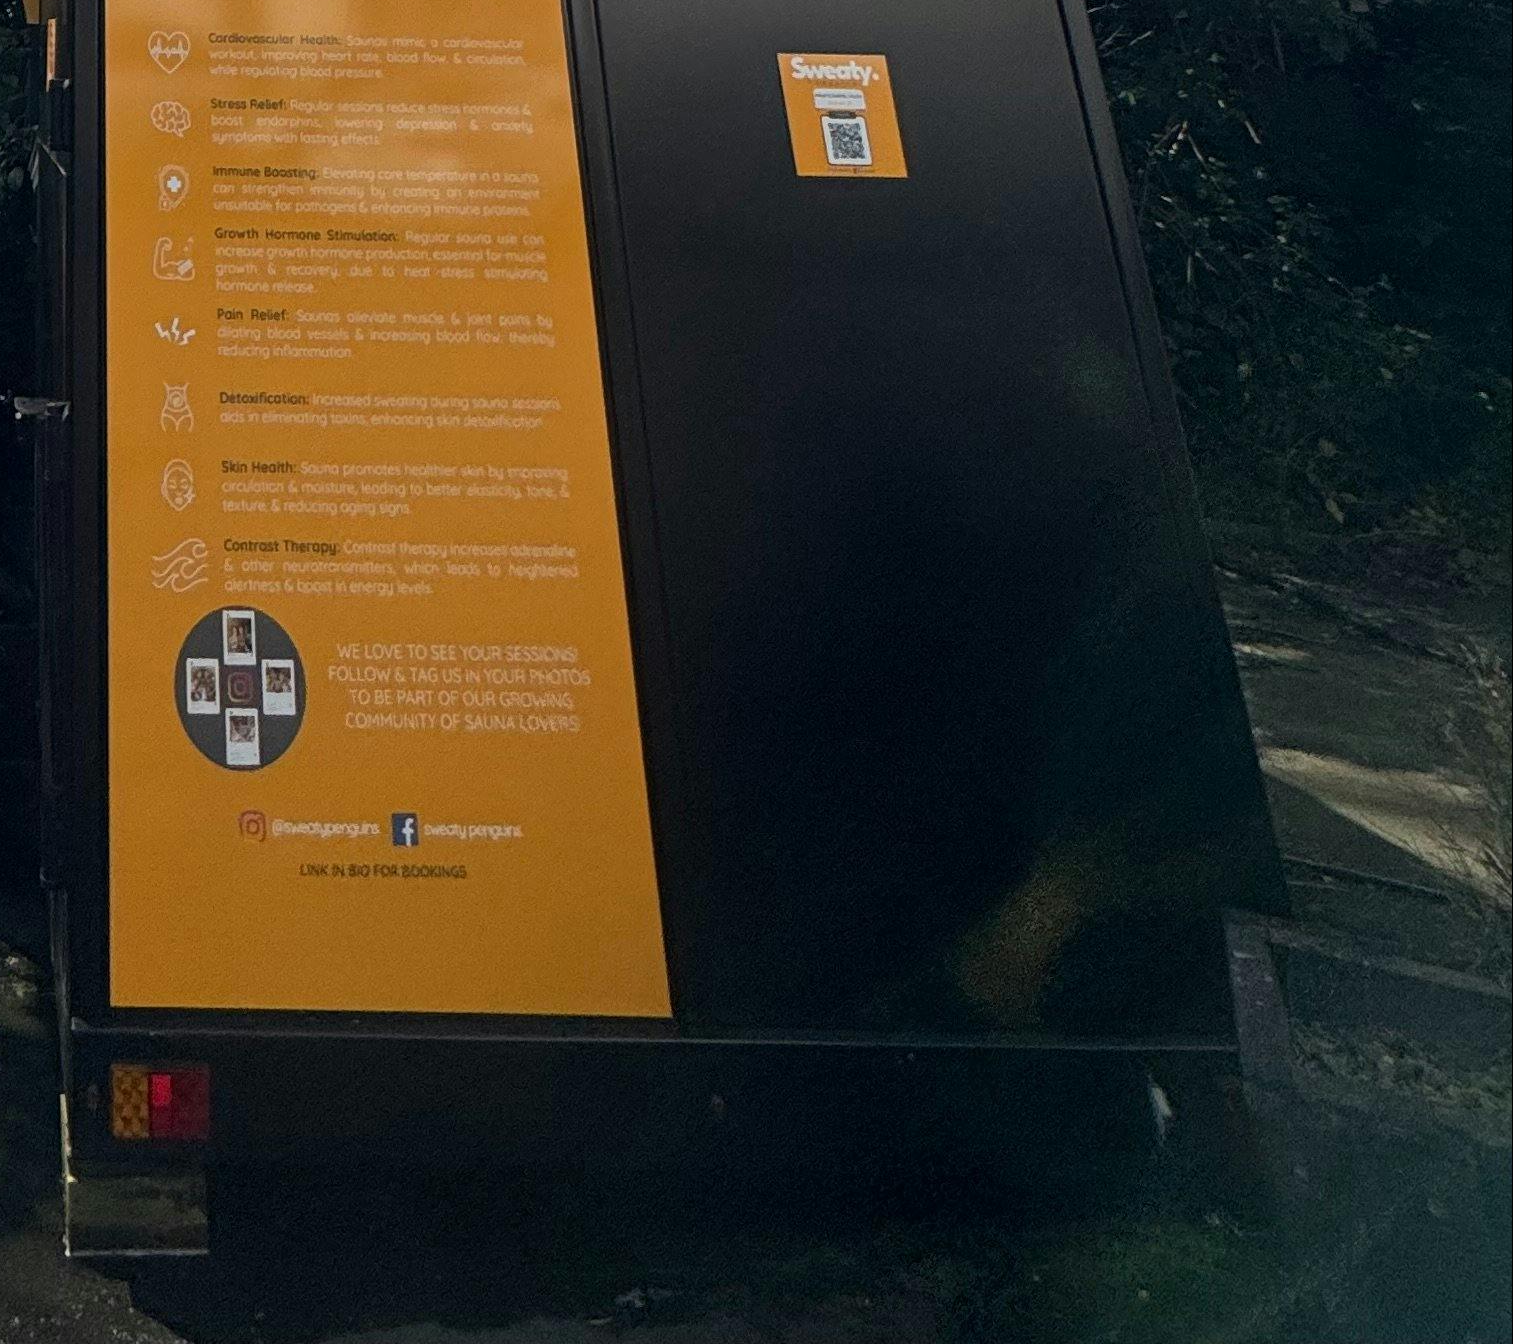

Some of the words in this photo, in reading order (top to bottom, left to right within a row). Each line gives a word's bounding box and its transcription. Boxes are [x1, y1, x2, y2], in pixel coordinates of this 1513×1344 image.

[208, 32, 295, 44] Cardiovascular
[791, 56, 880, 86] Sweaty.
[210, 98, 246, 109] Stress
[213, 166, 260, 178] Immune
[214, 227, 259, 239] Growth
[265, 228, 321, 241] Hormone
[217, 308, 243, 320] Pain
[221, 460, 247, 473] Skin
[223, 539, 279, 552] Contrast
